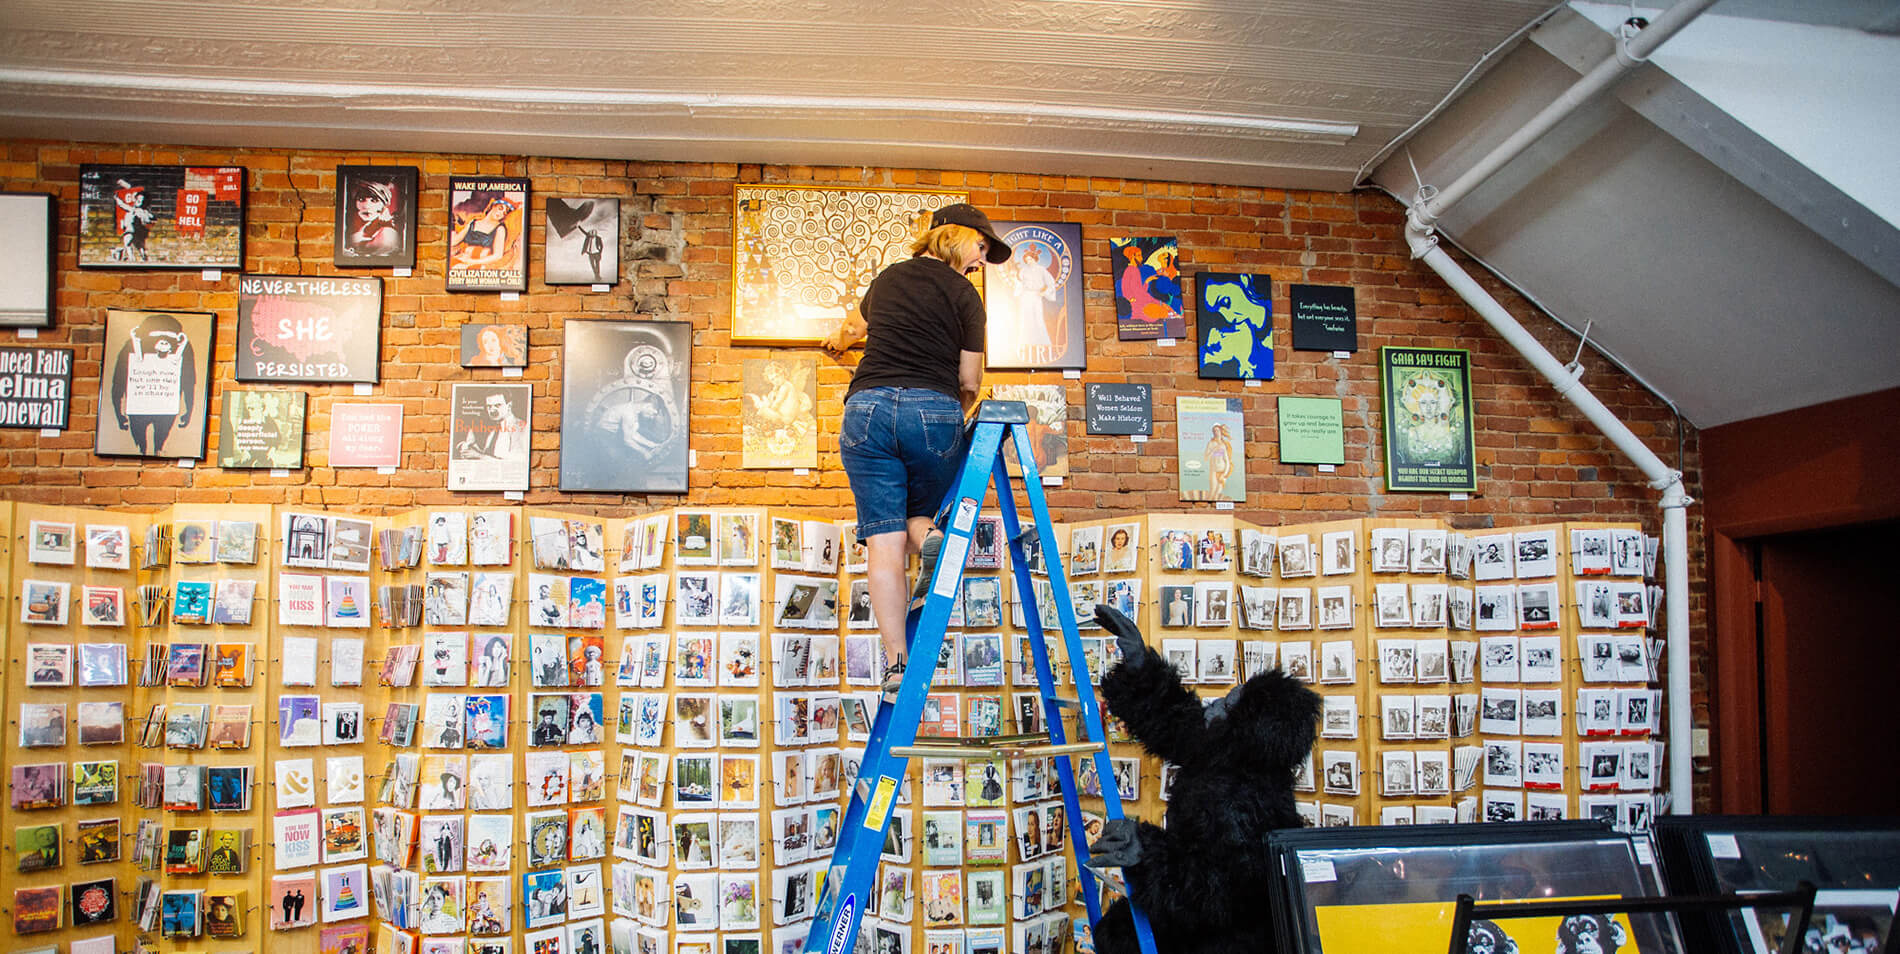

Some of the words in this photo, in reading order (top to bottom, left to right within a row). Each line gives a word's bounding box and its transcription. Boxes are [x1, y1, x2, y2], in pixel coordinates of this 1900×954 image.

[454, 182, 476, 190] WAKE
[186, 194, 199, 204] GO
[185, 206, 198, 215] TO
[179, 216, 201, 226] HELL
[1007, 230, 1029, 245] IGHT
[1032, 230, 1054, 243] LIKE
[1054, 242, 1062, 250] A
[278, 317, 332, 340] SHE
[1016, 344, 1057, 362] GIRL
[1392, 352, 1414, 365] GAIA
[1416, 353, 1433, 366] SAY
[1435, 354, 1462, 368] FIGHT
[0, 352, 33, 374] neca
[36, 350, 70, 375] Falls
[256, 361, 352, 378] PERSISTED.
[0, 374, 65, 400] elma
[0, 400, 64, 426] onewall
[289, 600, 314, 611] KISS
[285, 830, 310, 842] NOW
[285, 840, 310, 853] KISS
[830, 908, 851, 954] WERNER
